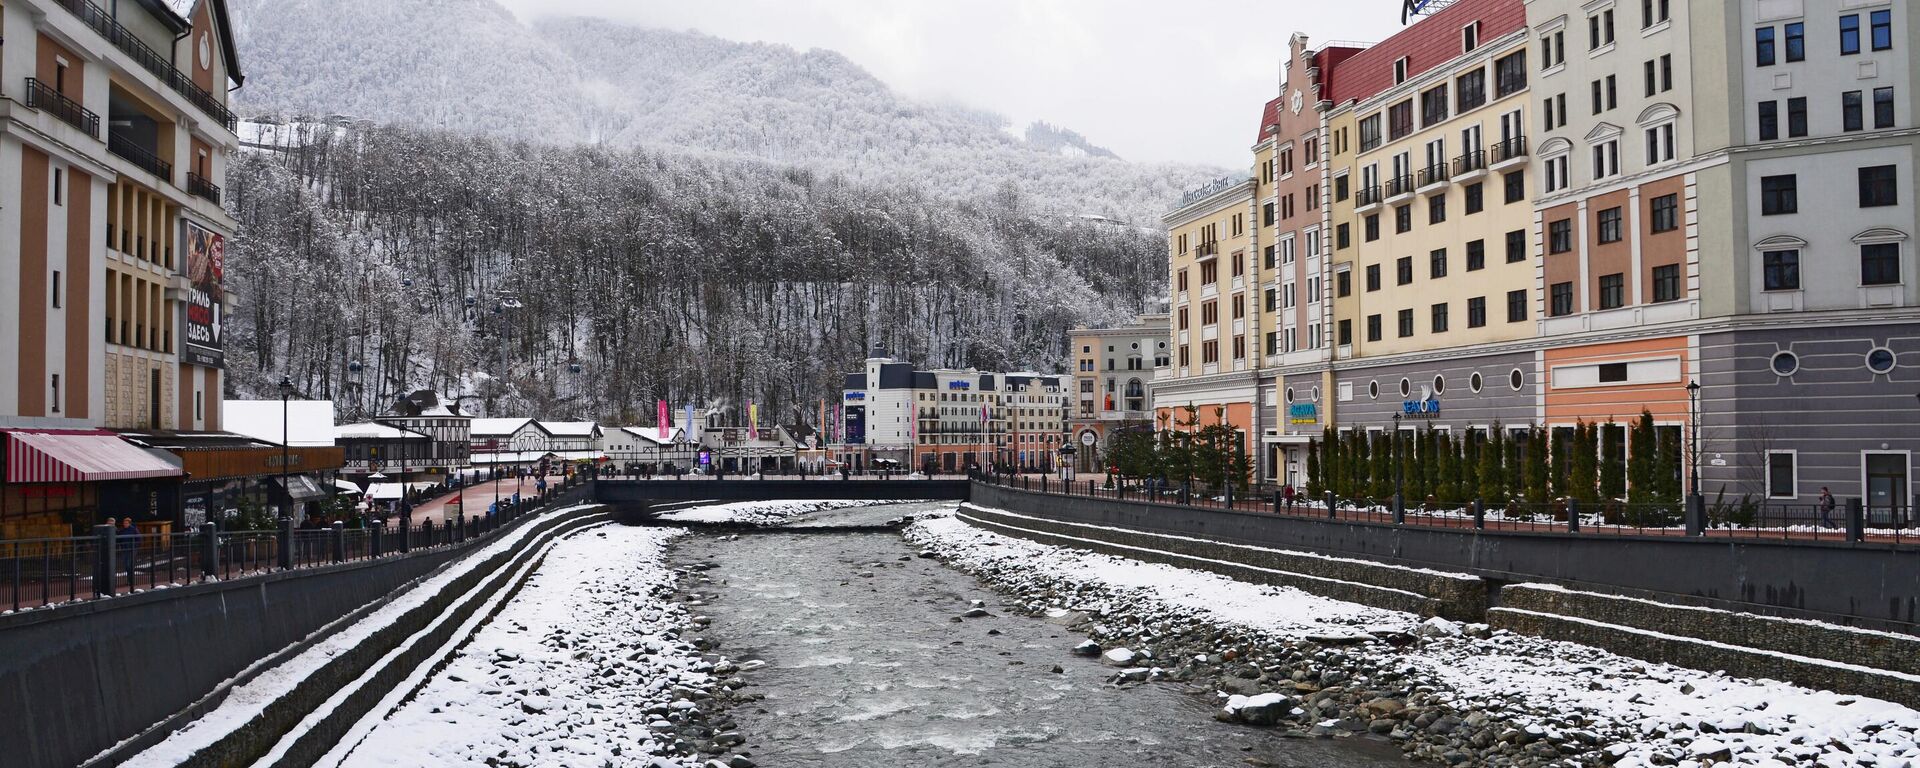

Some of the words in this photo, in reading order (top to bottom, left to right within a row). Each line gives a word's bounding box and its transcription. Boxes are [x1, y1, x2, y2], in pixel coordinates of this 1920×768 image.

[188, 287, 210, 308] ГРИЛЬ
[188, 322, 210, 342] ЗДЕСЬ
[1403, 398, 1440, 414] SEASONS
